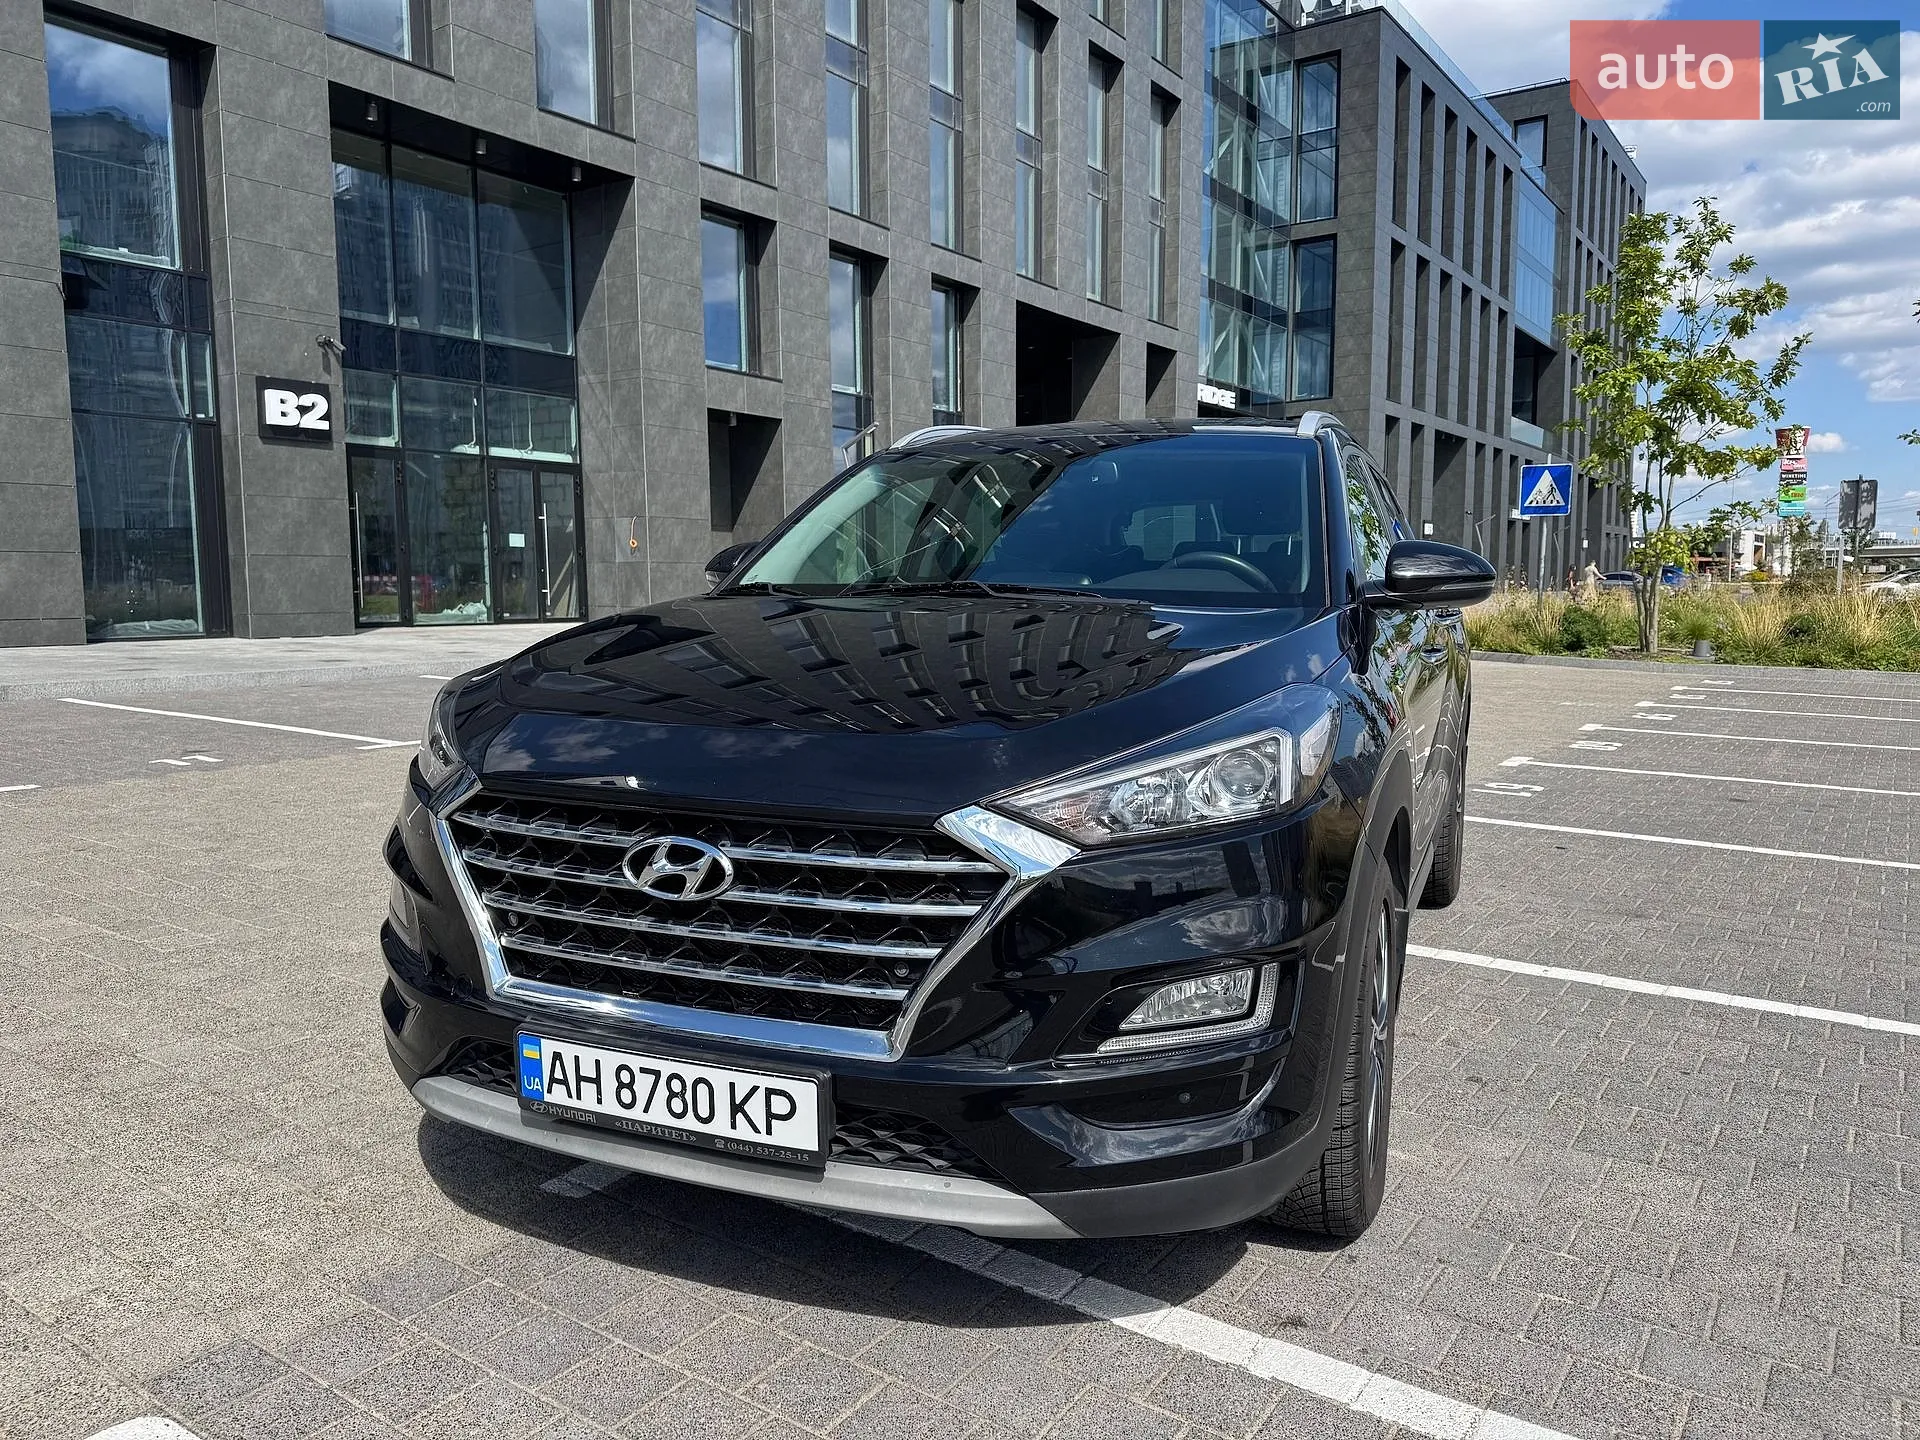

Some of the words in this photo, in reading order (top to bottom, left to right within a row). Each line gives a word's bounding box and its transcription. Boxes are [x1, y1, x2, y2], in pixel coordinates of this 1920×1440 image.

[264, 388, 330, 431] B2
[524, 1075, 543, 1093] UA
[546, 1051, 602, 1105] AH
[615, 1063, 715, 1125] 8780
[729, 1081, 797, 1136] KP
[548, 1105, 598, 1124] HYUNDAI
[615, 1120, 697, 1142] «ПАРИТЕТ»
[727, 1142, 754, 1154] (044)
[756, 1146, 809, 1162] 537-25-15
